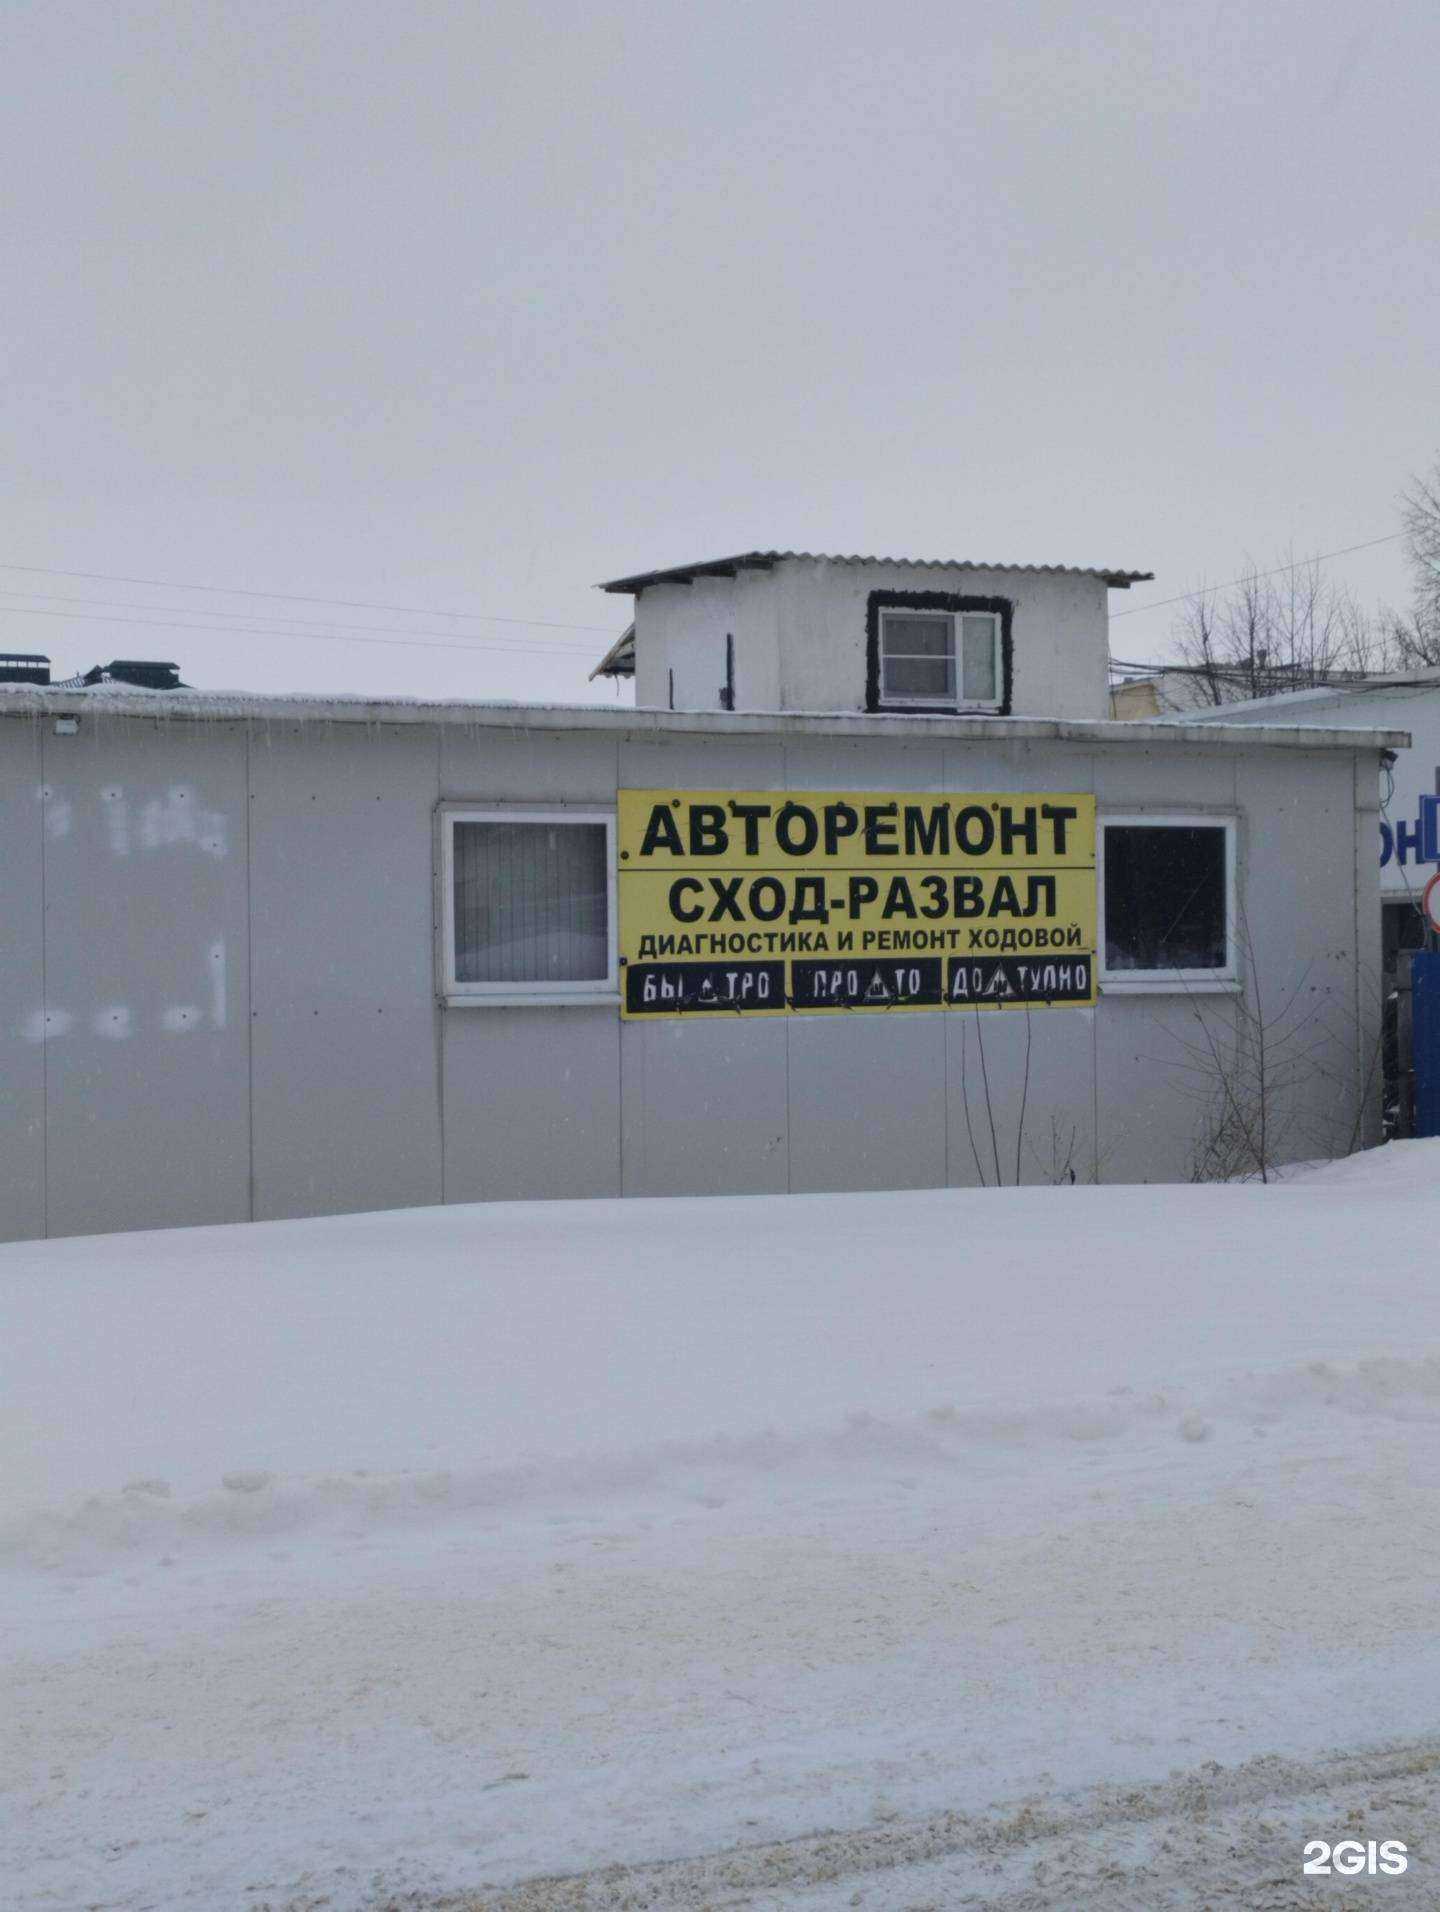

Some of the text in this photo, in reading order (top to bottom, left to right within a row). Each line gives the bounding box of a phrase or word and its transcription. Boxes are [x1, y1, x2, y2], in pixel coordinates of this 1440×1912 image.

[639, 804, 1078, 857] АВТОРЕМОНТ
[668, 875, 1057, 925] СХОД-РАЗВАЛ
[638, 923, 1082, 959] ДИАГНОСТИКА И РЕМОНТ ХОДОВОЙ
